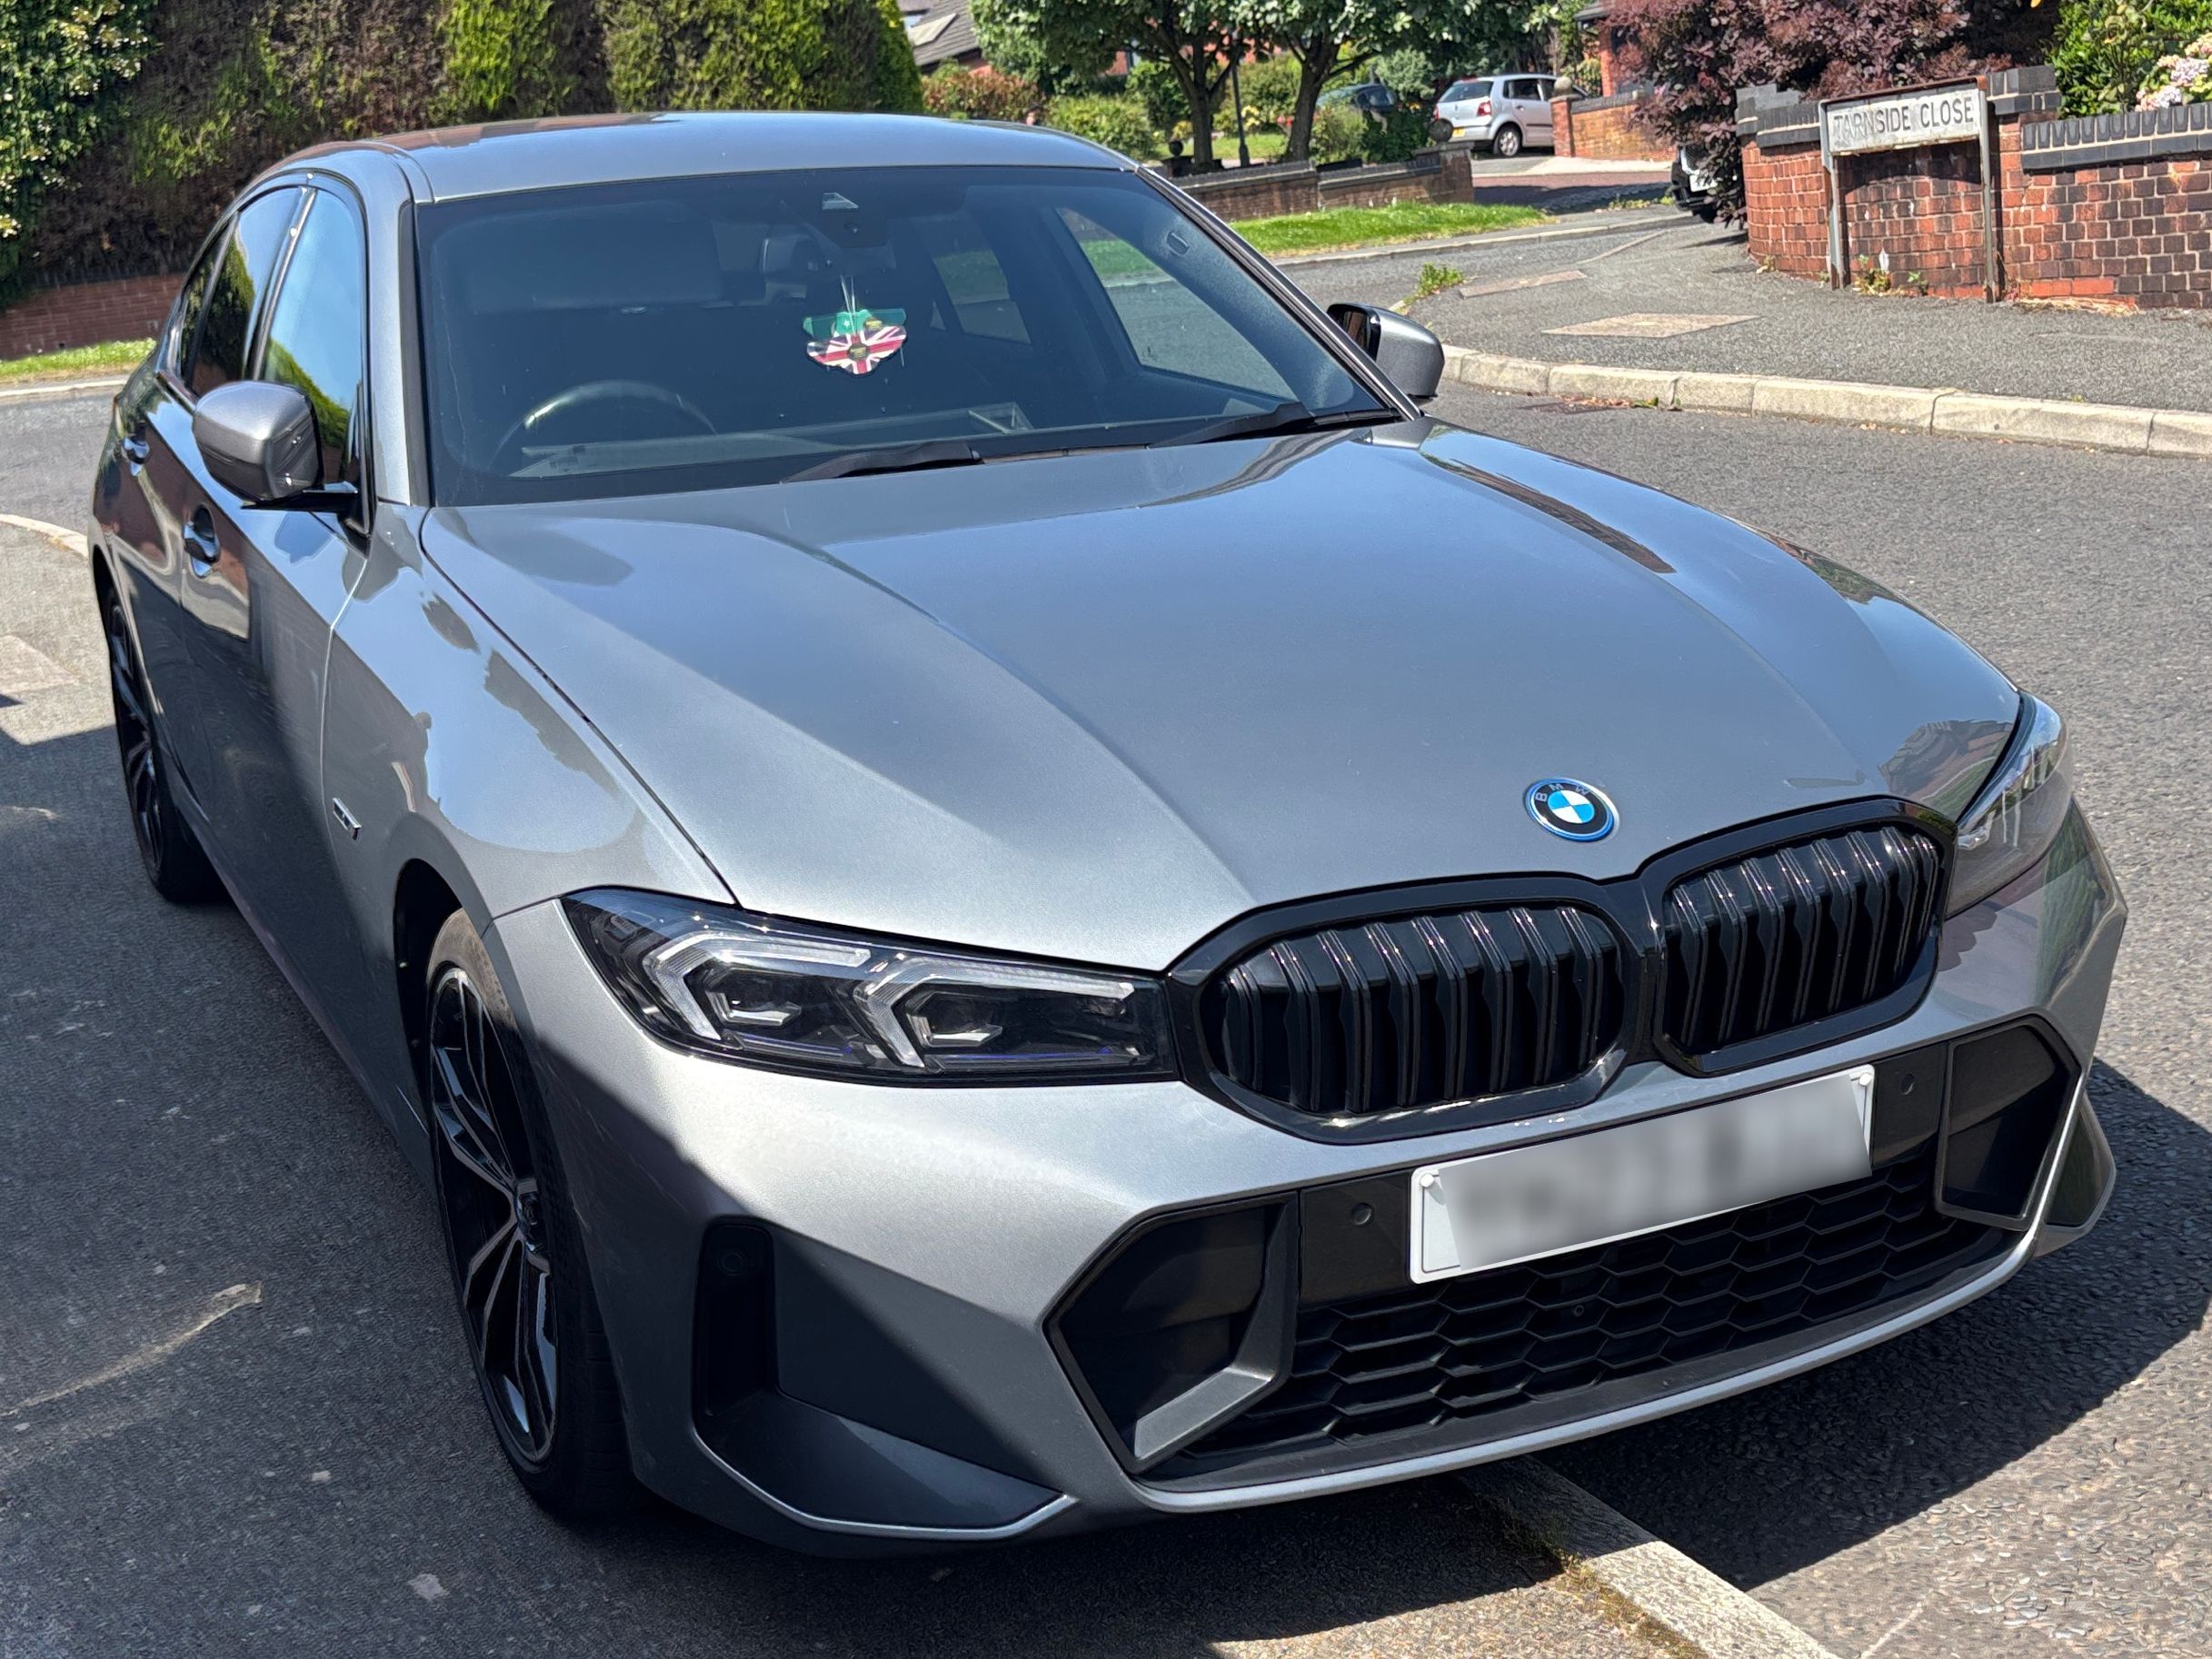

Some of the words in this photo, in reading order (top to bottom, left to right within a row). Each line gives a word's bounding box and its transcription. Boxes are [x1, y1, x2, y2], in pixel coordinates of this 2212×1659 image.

[1833, 105, 1911, 139] TARNSIDE
[1919, 96, 1974, 128] CLOSE
[1534, 783, 1589, 802] BMW
